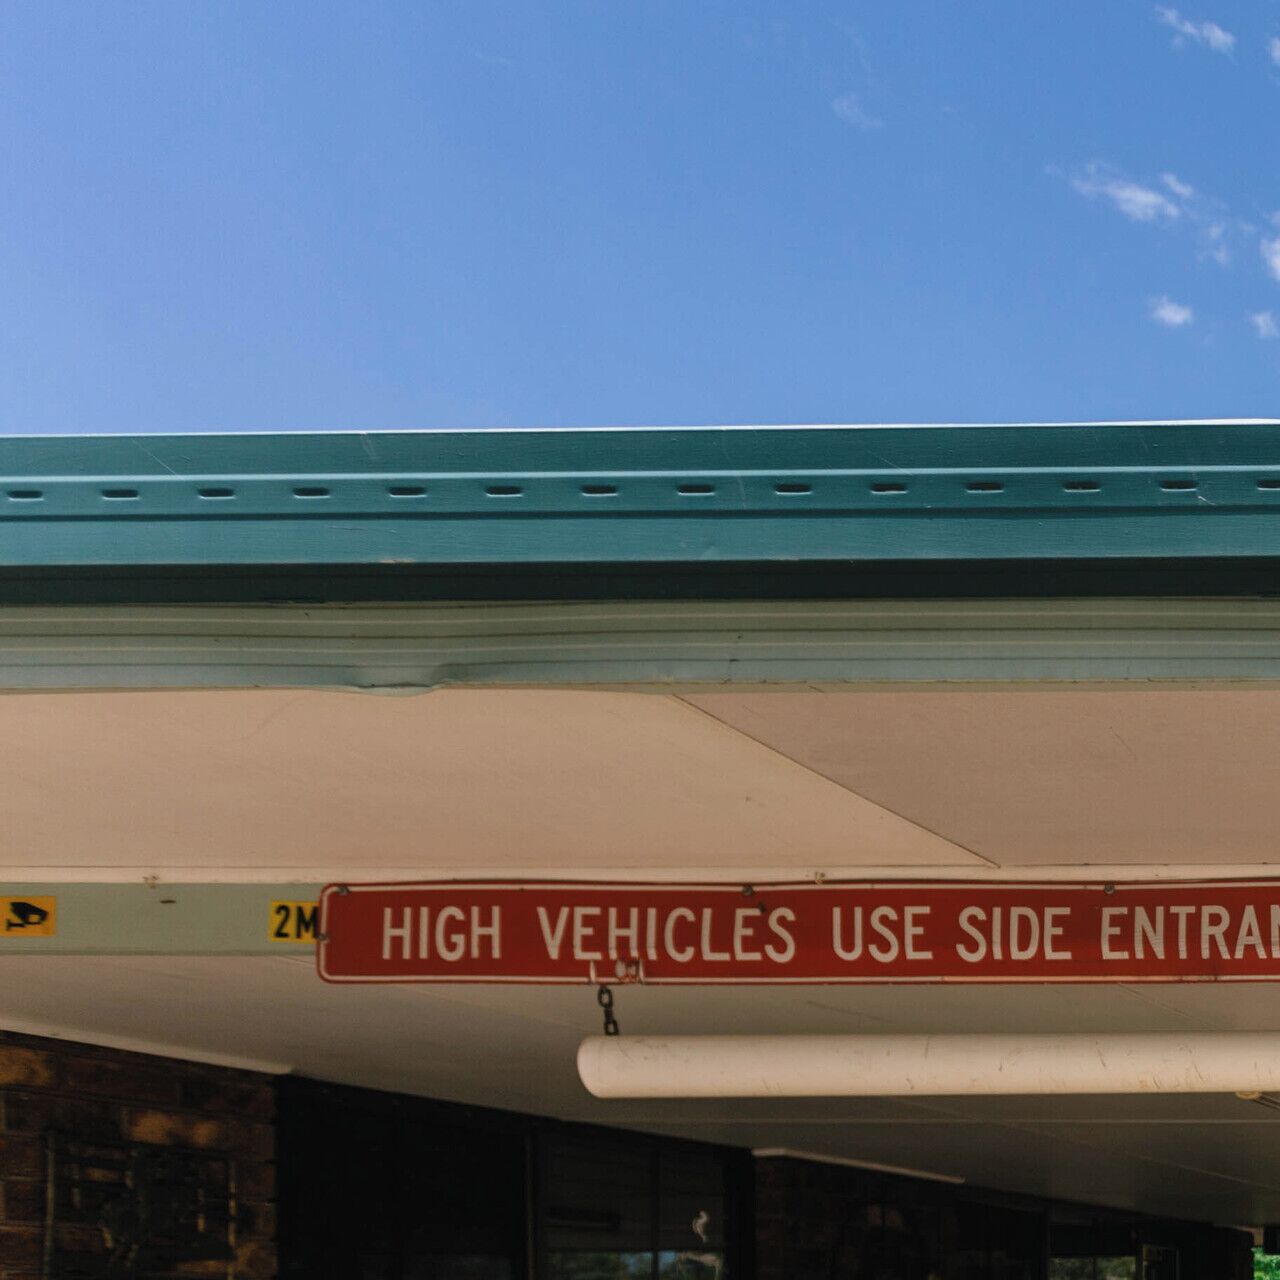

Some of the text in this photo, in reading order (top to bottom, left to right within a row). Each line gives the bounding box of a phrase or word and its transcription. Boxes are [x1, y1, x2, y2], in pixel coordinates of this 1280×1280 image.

[274, 905, 319, 939] 2M
[382, 906, 502, 960] HIGH
[537, 906, 796, 963] VEHICLES
[831, 905, 933, 962] USE
[956, 905, 1072, 961] SIDE
